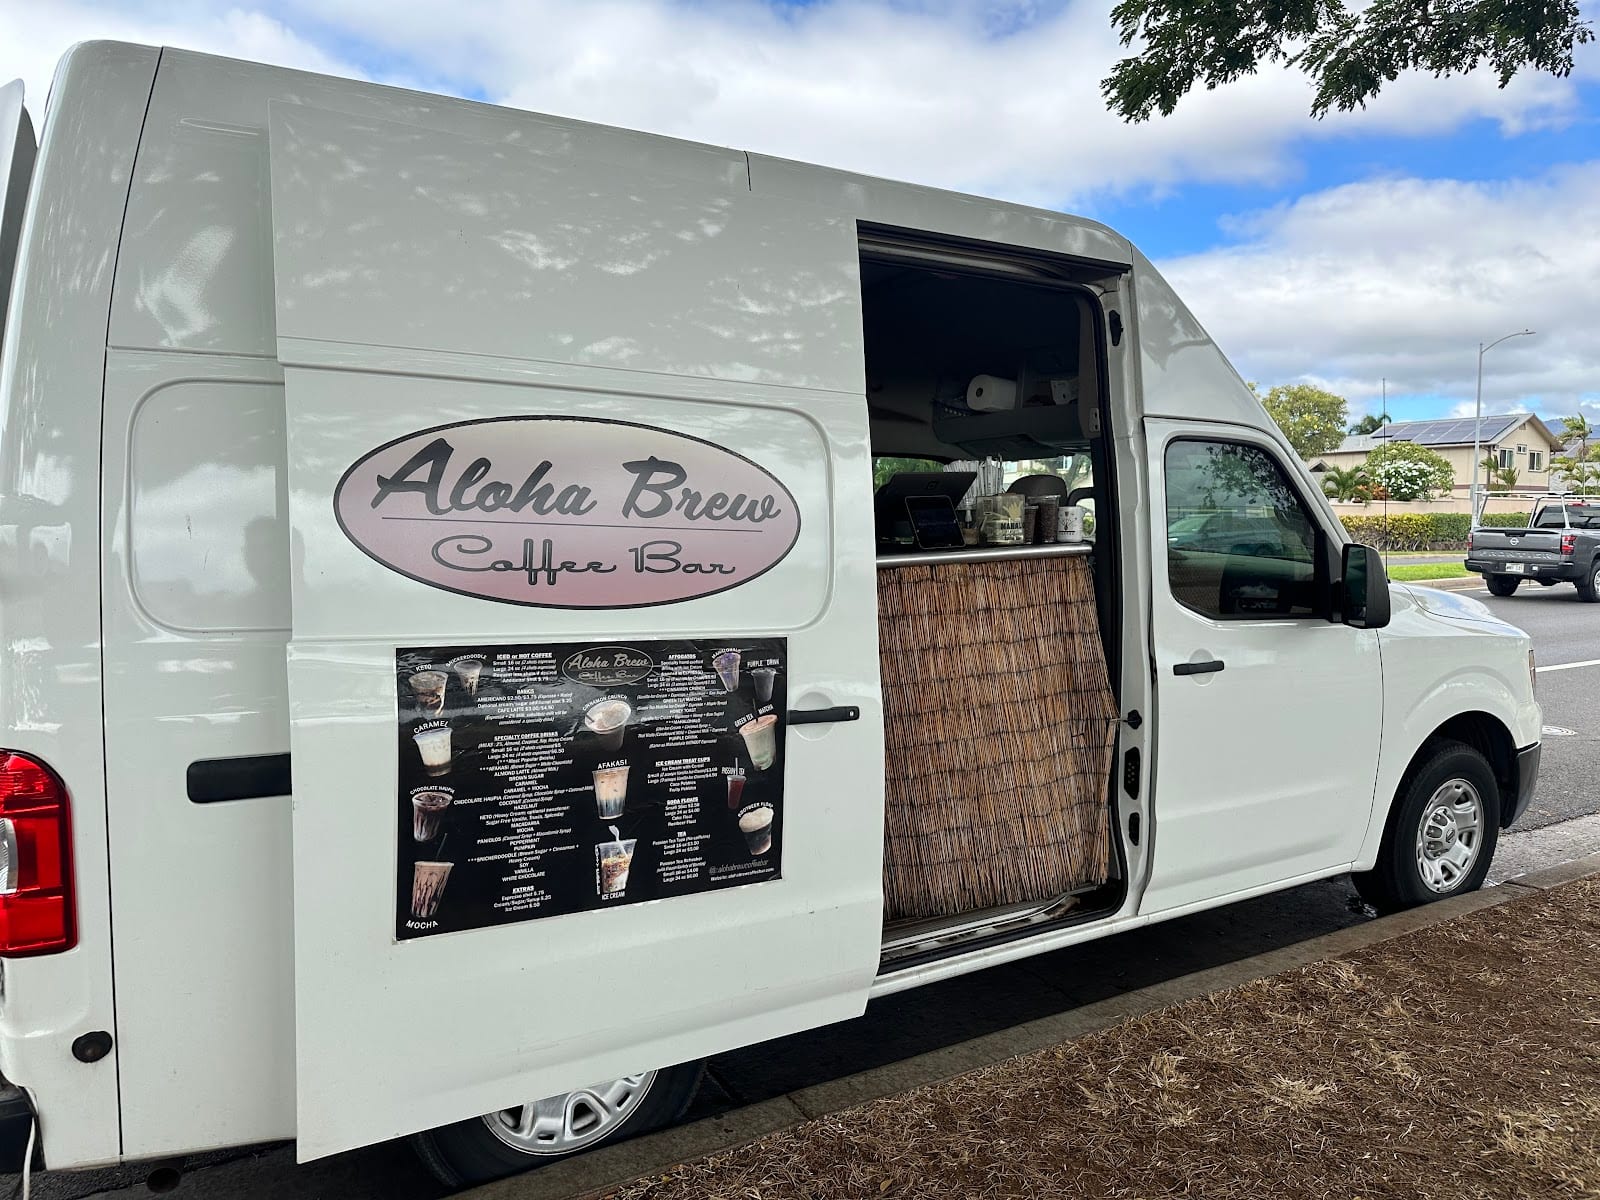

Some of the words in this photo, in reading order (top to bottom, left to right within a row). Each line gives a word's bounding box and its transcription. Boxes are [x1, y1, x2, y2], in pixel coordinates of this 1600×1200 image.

[371, 438, 597, 516] Aloha
[622, 455, 781, 523] Brew
[431, 534, 617, 586] Coffee
[629, 540, 735, 574] Bar
[496, 654, 511, 662] ICED
[518, 653, 530, 661] HOT
[531, 652, 553, 660] COFFEE
[568, 653, 610, 670] Aloha
[613, 653, 649, 667] Brew
[668, 653, 697, 661] AFFOGATOS
[415, 664, 432, 672] KETO
[746, 659, 763, 668] PURPLE
[477, 695, 507, 703] AMERICANO
[582, 695, 607, 711] CINNAMON
[413, 720, 449, 733] CARAMEL
[493, 734, 520, 742] SPECIALTY
[520, 732, 539, 740] COFFEE
[597, 758, 628, 770] AFAKASI
[664, 759, 683, 767] CREAM
[682, 757, 698, 765] TREAT
[697, 756, 711, 764] CUPS
[493, 769, 516, 778] ALMOND
[515, 768, 531, 776] LATTE
[508, 775, 528, 783] BROWN
[527, 773, 545, 781] SUGAR
[410, 785, 438, 795] CHOCOLATE
[503, 786, 527, 795] CARAMEL
[531, 784, 549, 793] MOCHA
[453, 797, 483, 806] CHOCOLATE
[483, 795, 502, 803] HAUPIA
[498, 799, 522, 807] COCONUT
[680, 796, 699, 805] FLOATS
[513, 803, 538, 811] HAZELNUT
[479, 813, 493, 821] KETO
[485, 819, 501, 827] Sugar
[510, 820, 540, 829] MACADAMIA
[516, 826, 534, 834] MOCHA
[509, 838, 540, 847] PEPPERMINT
[513, 844, 536, 852] PUMPKIN
[514, 867, 534, 875] VANILLA
[501, 875, 518, 883] WHITE
[517, 871, 546, 881] CHOCOLATE
[512, 885, 535, 894] EXTRAS
[601, 893, 610, 901] ICE
[609, 890, 626, 899] CREAM
[405, 919, 439, 930] MOCHA
